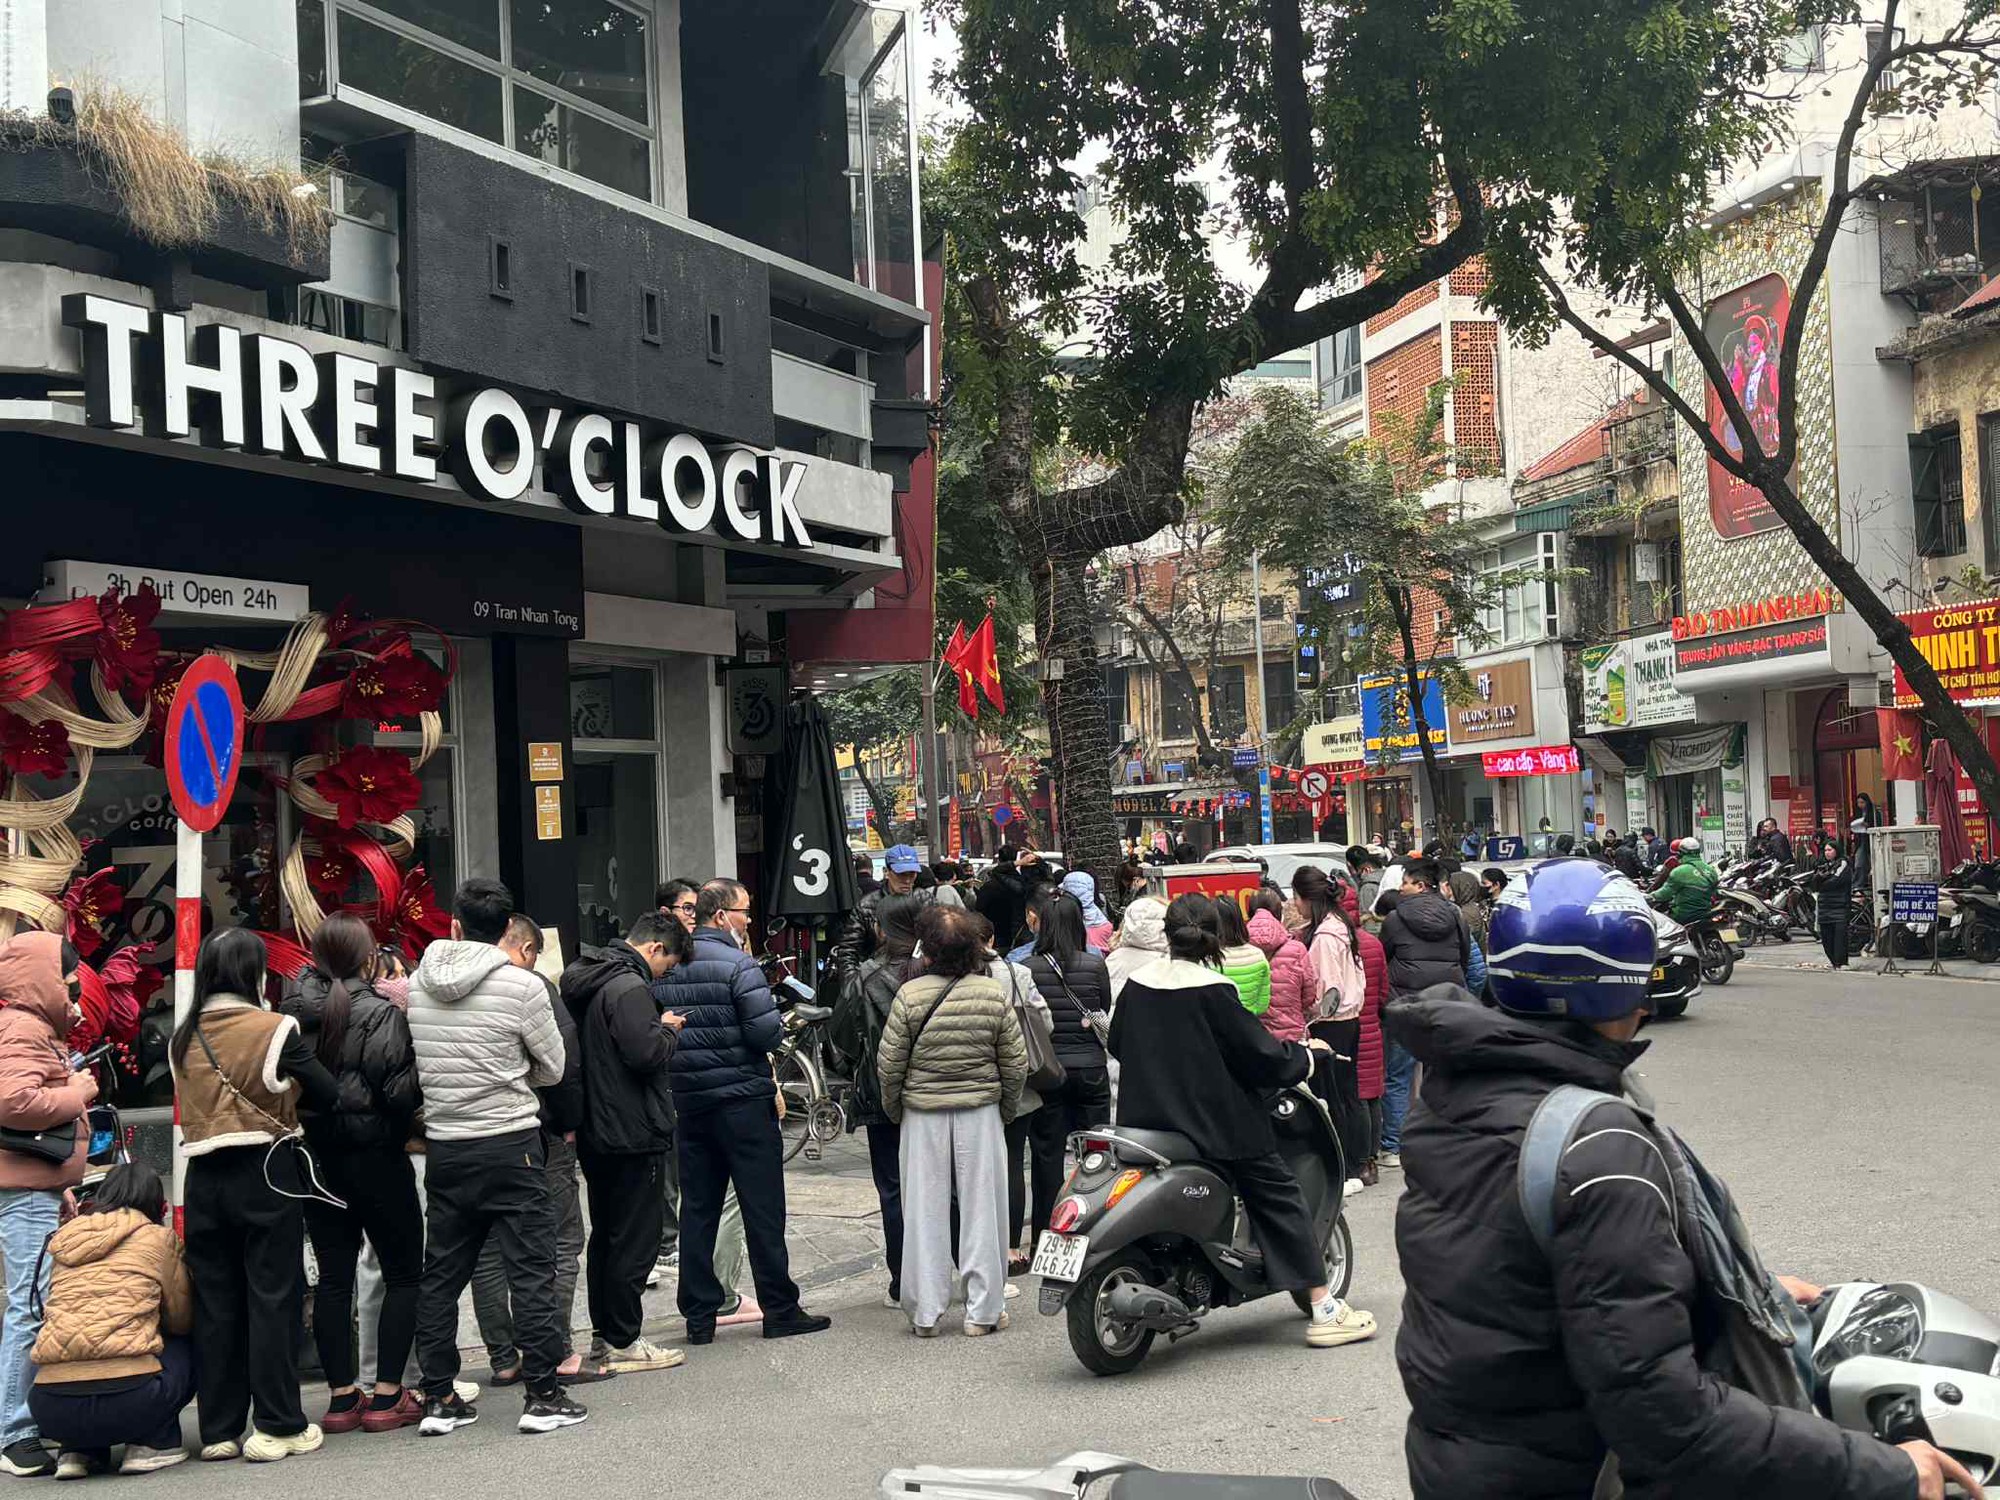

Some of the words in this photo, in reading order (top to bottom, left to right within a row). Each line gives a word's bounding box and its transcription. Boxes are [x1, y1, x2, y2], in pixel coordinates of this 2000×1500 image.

[80, 293, 437, 481] THREE
[463, 387, 814, 548] O'CLOCK
[183, 580, 233, 608] Open
[243, 586, 278, 610] 24h
[473, 601, 490, 617] 09
[493, 603, 518, 621] Tran
[521, 607, 549, 624] Nhan
[553, 609, 579, 631] Tong
[1933, 609, 1973, 629] CÔNG
[1975, 606, 1997, 623] TY
[1982, 625, 2000, 665] T
[1678, 648, 1709, 666] TRUNG
[1950, 672, 1968, 689] CHỮ
[1970, 671, 1985, 687] TÍN
[1497, 756, 1513, 772] cao
[1515, 749, 1534, 773] cấp
[1539, 749, 1566, 772] Vàng
[1112, 797, 1158, 813] MODEL
[1893, 899, 1909, 910] NƠI
[1925, 901, 1937, 911] XE
[1895, 911, 1909, 921] CƠ
[1910, 911, 1935, 922] QUAN
[1033, 1254, 1077, 1278] 046.24
